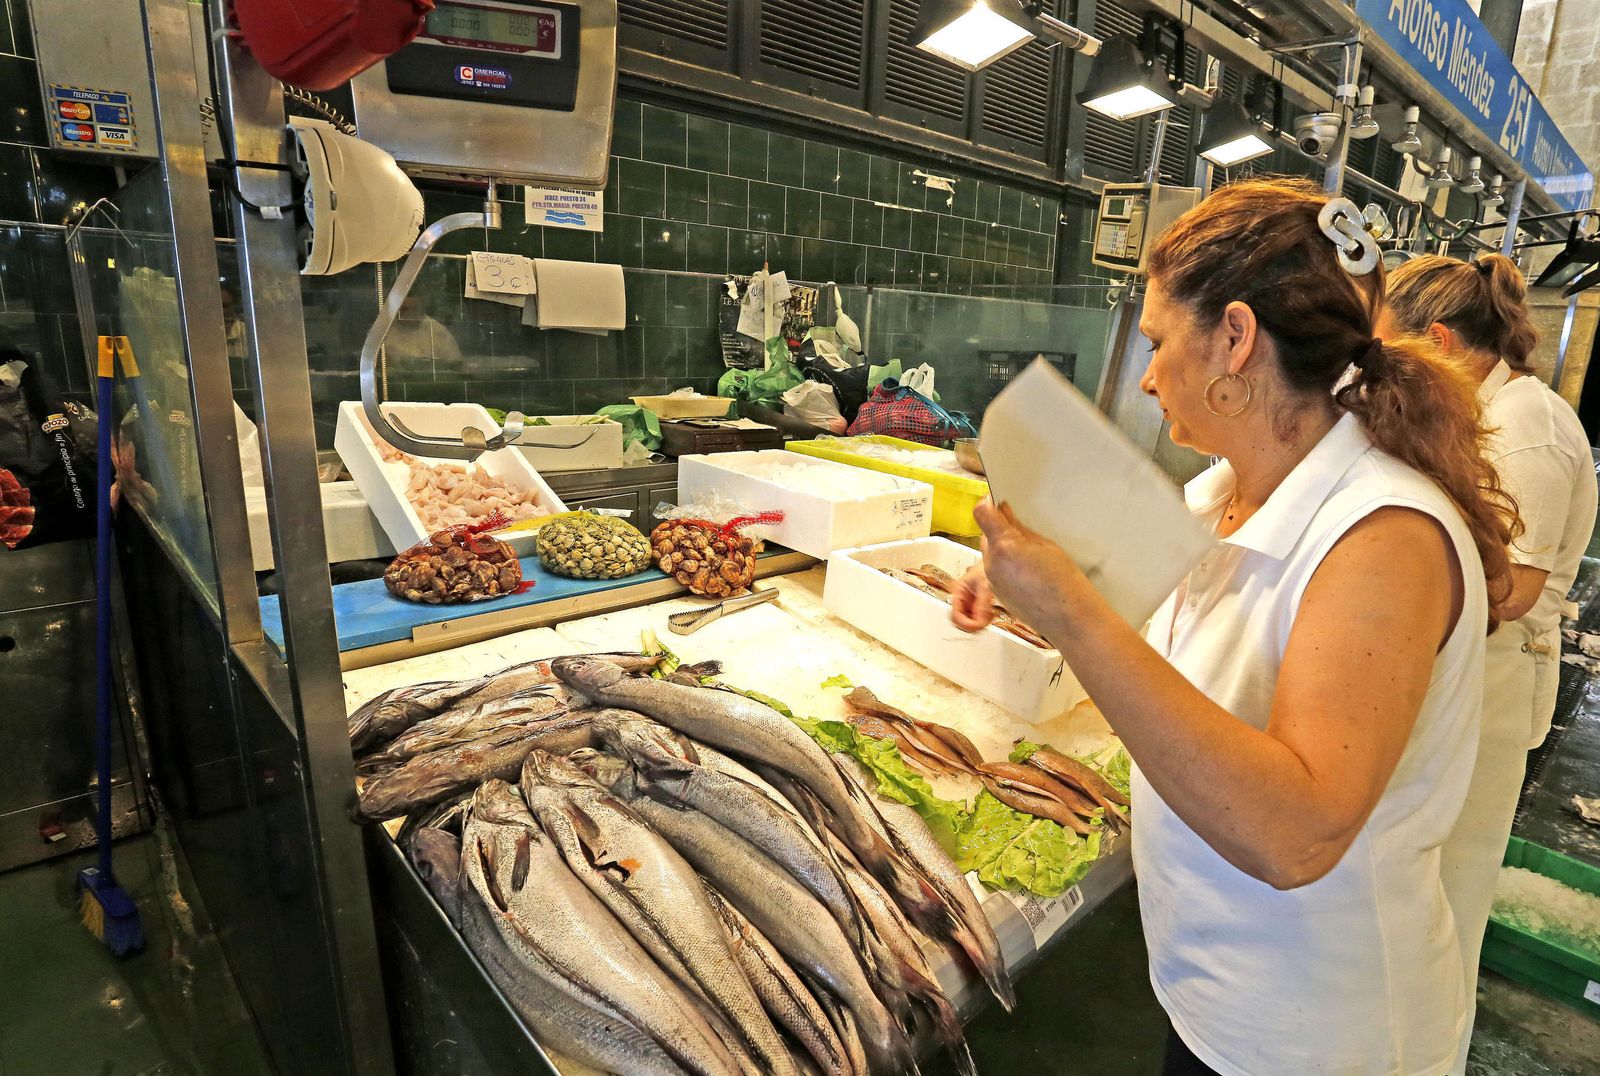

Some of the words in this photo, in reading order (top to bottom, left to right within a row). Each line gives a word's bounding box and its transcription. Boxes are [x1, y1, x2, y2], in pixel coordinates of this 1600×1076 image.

[1447, 16, 1495, 120] Méndez
[1499, 75, 1533, 158] 251
[72, 91, 100, 100] TELEPAGO
[65, 128, 91, 136] Maestro
[105, 132, 125, 140] VISA
[55, 433, 65, 442] fin
[60, 447, 77, 477] principio
[70, 476, 77, 484] de
[72, 484, 85, 509] Contigo
